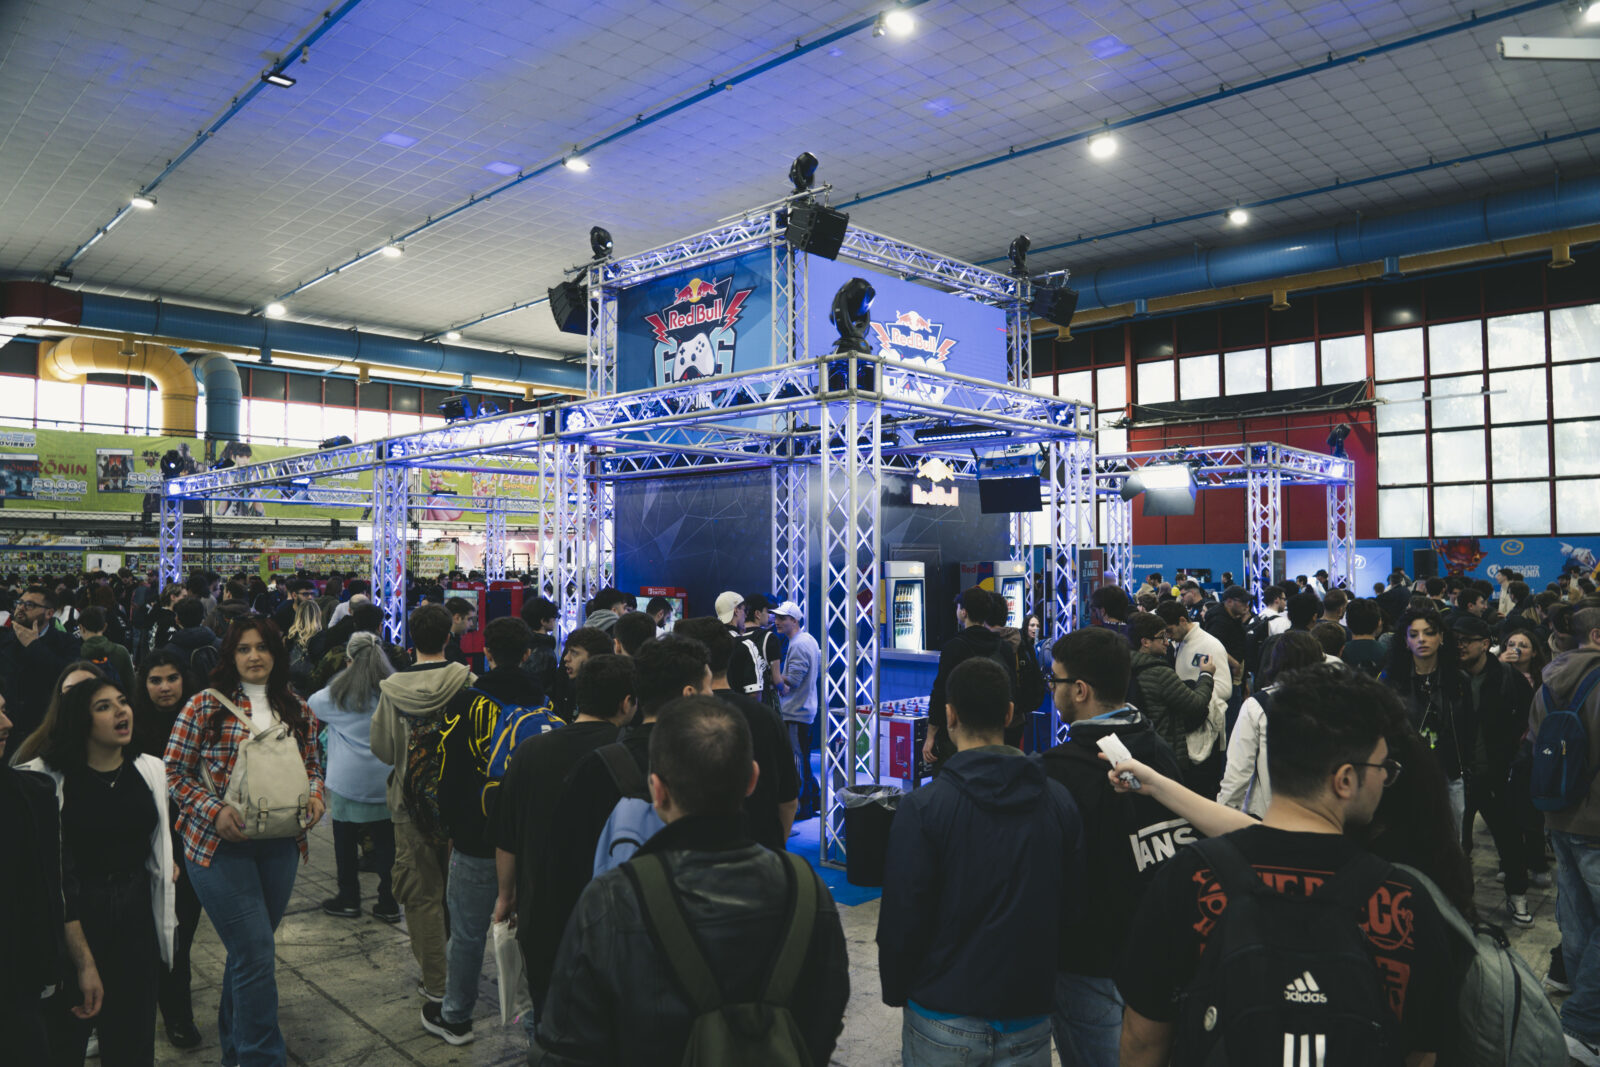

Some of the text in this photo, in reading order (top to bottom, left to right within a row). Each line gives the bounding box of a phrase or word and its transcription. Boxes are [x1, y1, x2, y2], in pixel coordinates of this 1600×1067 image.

[668, 298, 723, 331] Red Bull
[891, 327, 937, 352] Red Bull
[1284, 990, 1328, 1003] adidas
